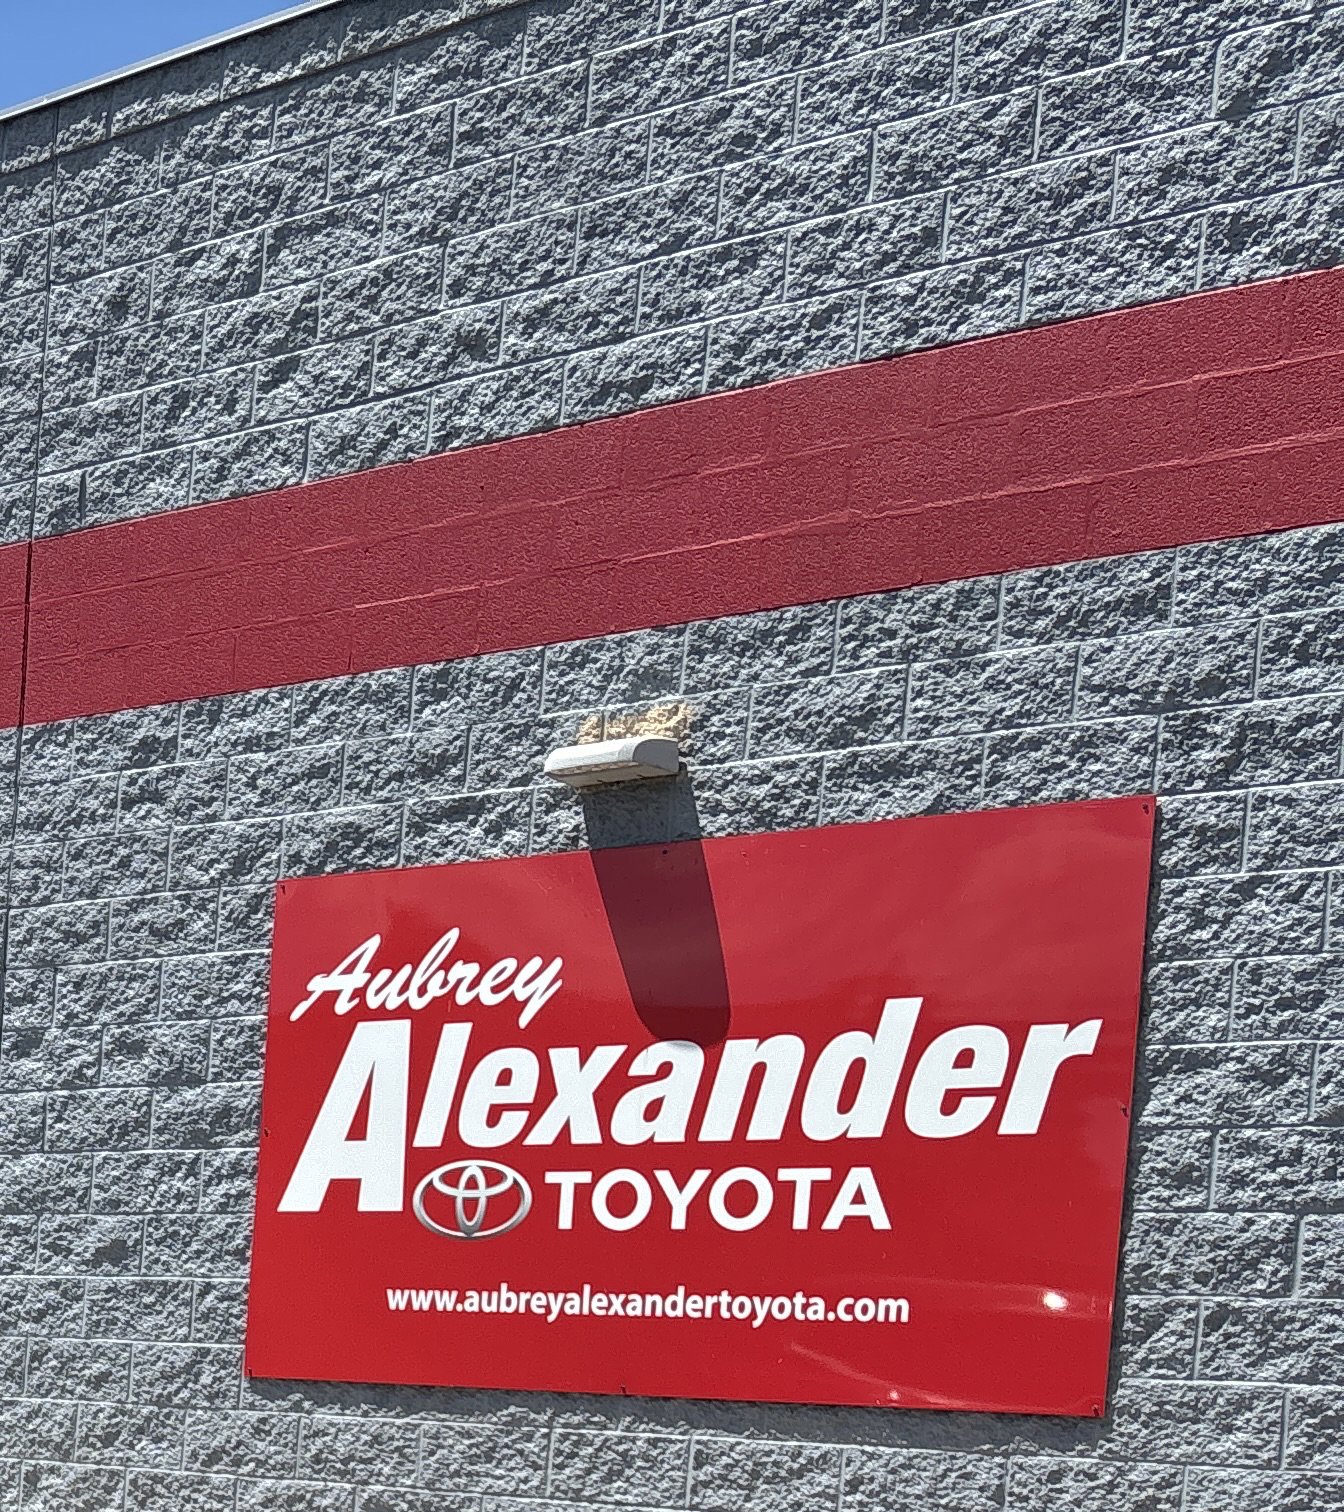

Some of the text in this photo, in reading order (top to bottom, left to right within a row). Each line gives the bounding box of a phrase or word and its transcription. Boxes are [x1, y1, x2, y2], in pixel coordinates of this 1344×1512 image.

[290, 927, 562, 1031] Aubrey
[277, 997, 1103, 1213] Alexander
[546, 1166, 892, 1231] TOYOTA
[386, 1282, 910, 1329] www.aubreyalexandertoyota.com
